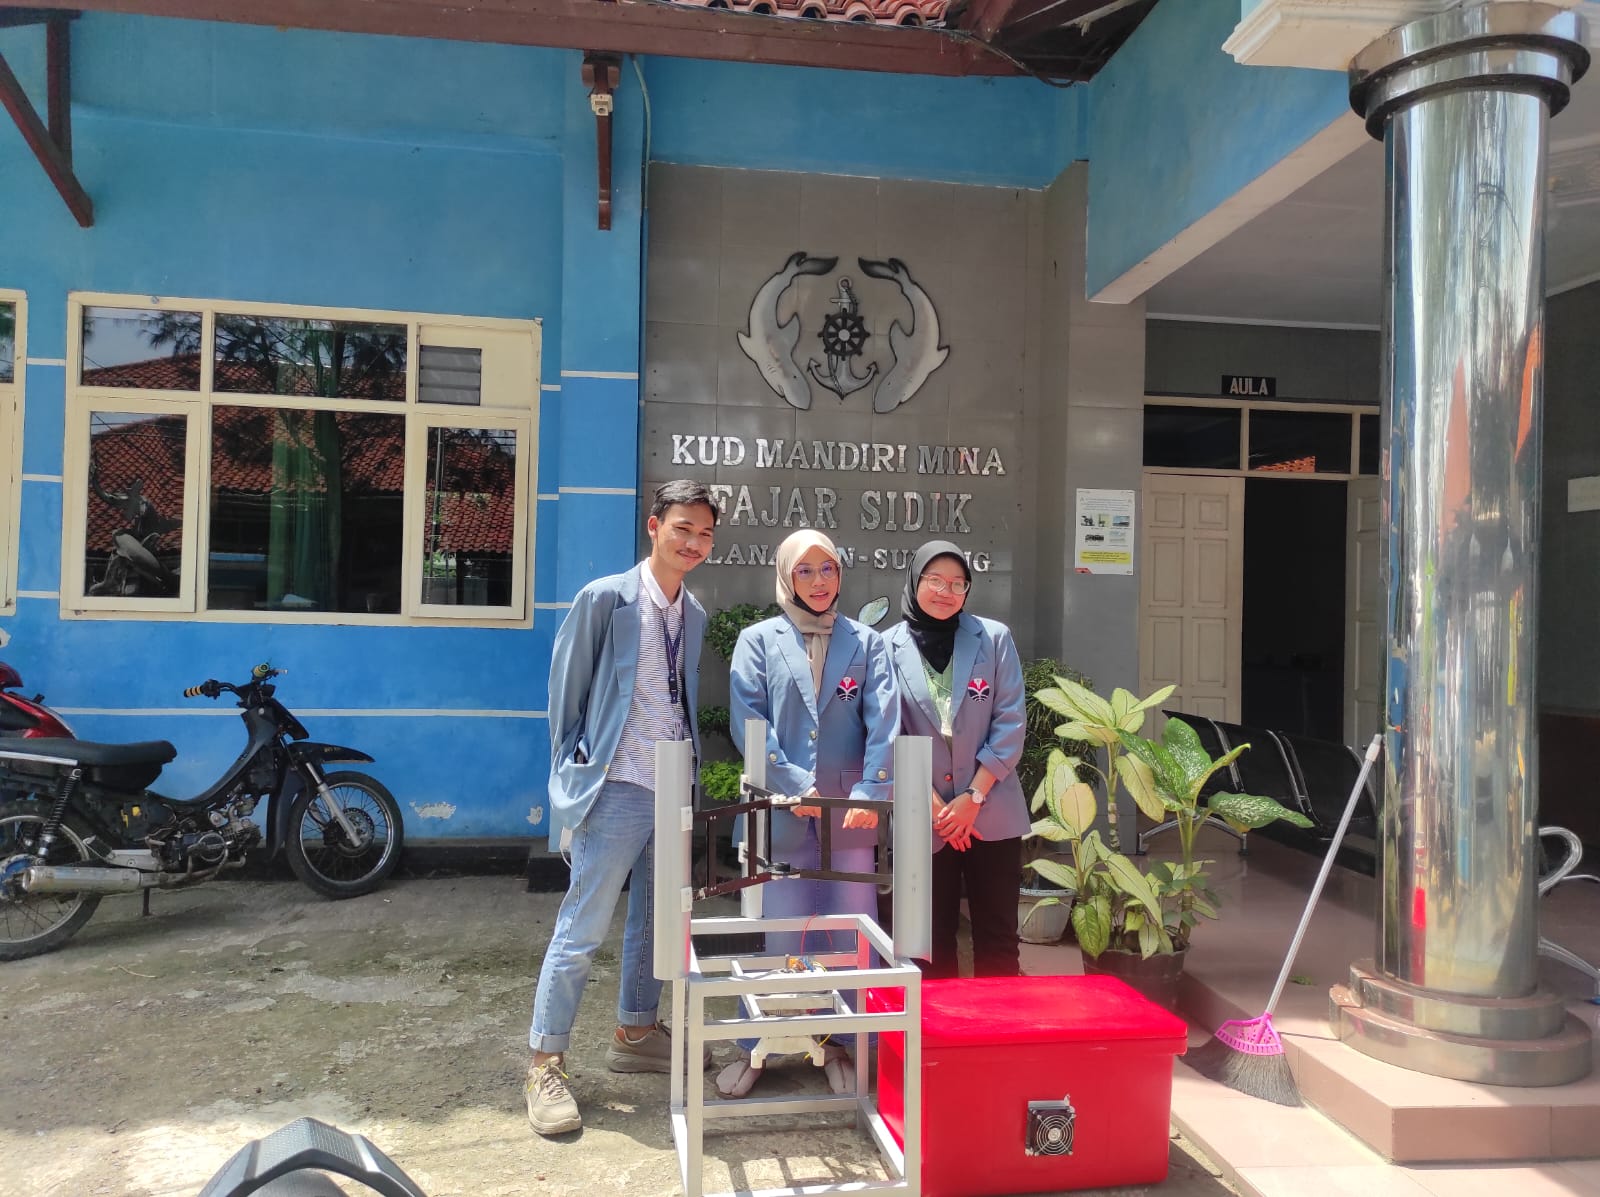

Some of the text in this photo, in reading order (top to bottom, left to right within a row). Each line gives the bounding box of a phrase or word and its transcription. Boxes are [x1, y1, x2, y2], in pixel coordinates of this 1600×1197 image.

[1230, 377, 1269, 395] AULA
[671, 434, 1006, 476] KUD MANDIRI MINA
[709, 484, 972, 533] FAJAR SIDIK
